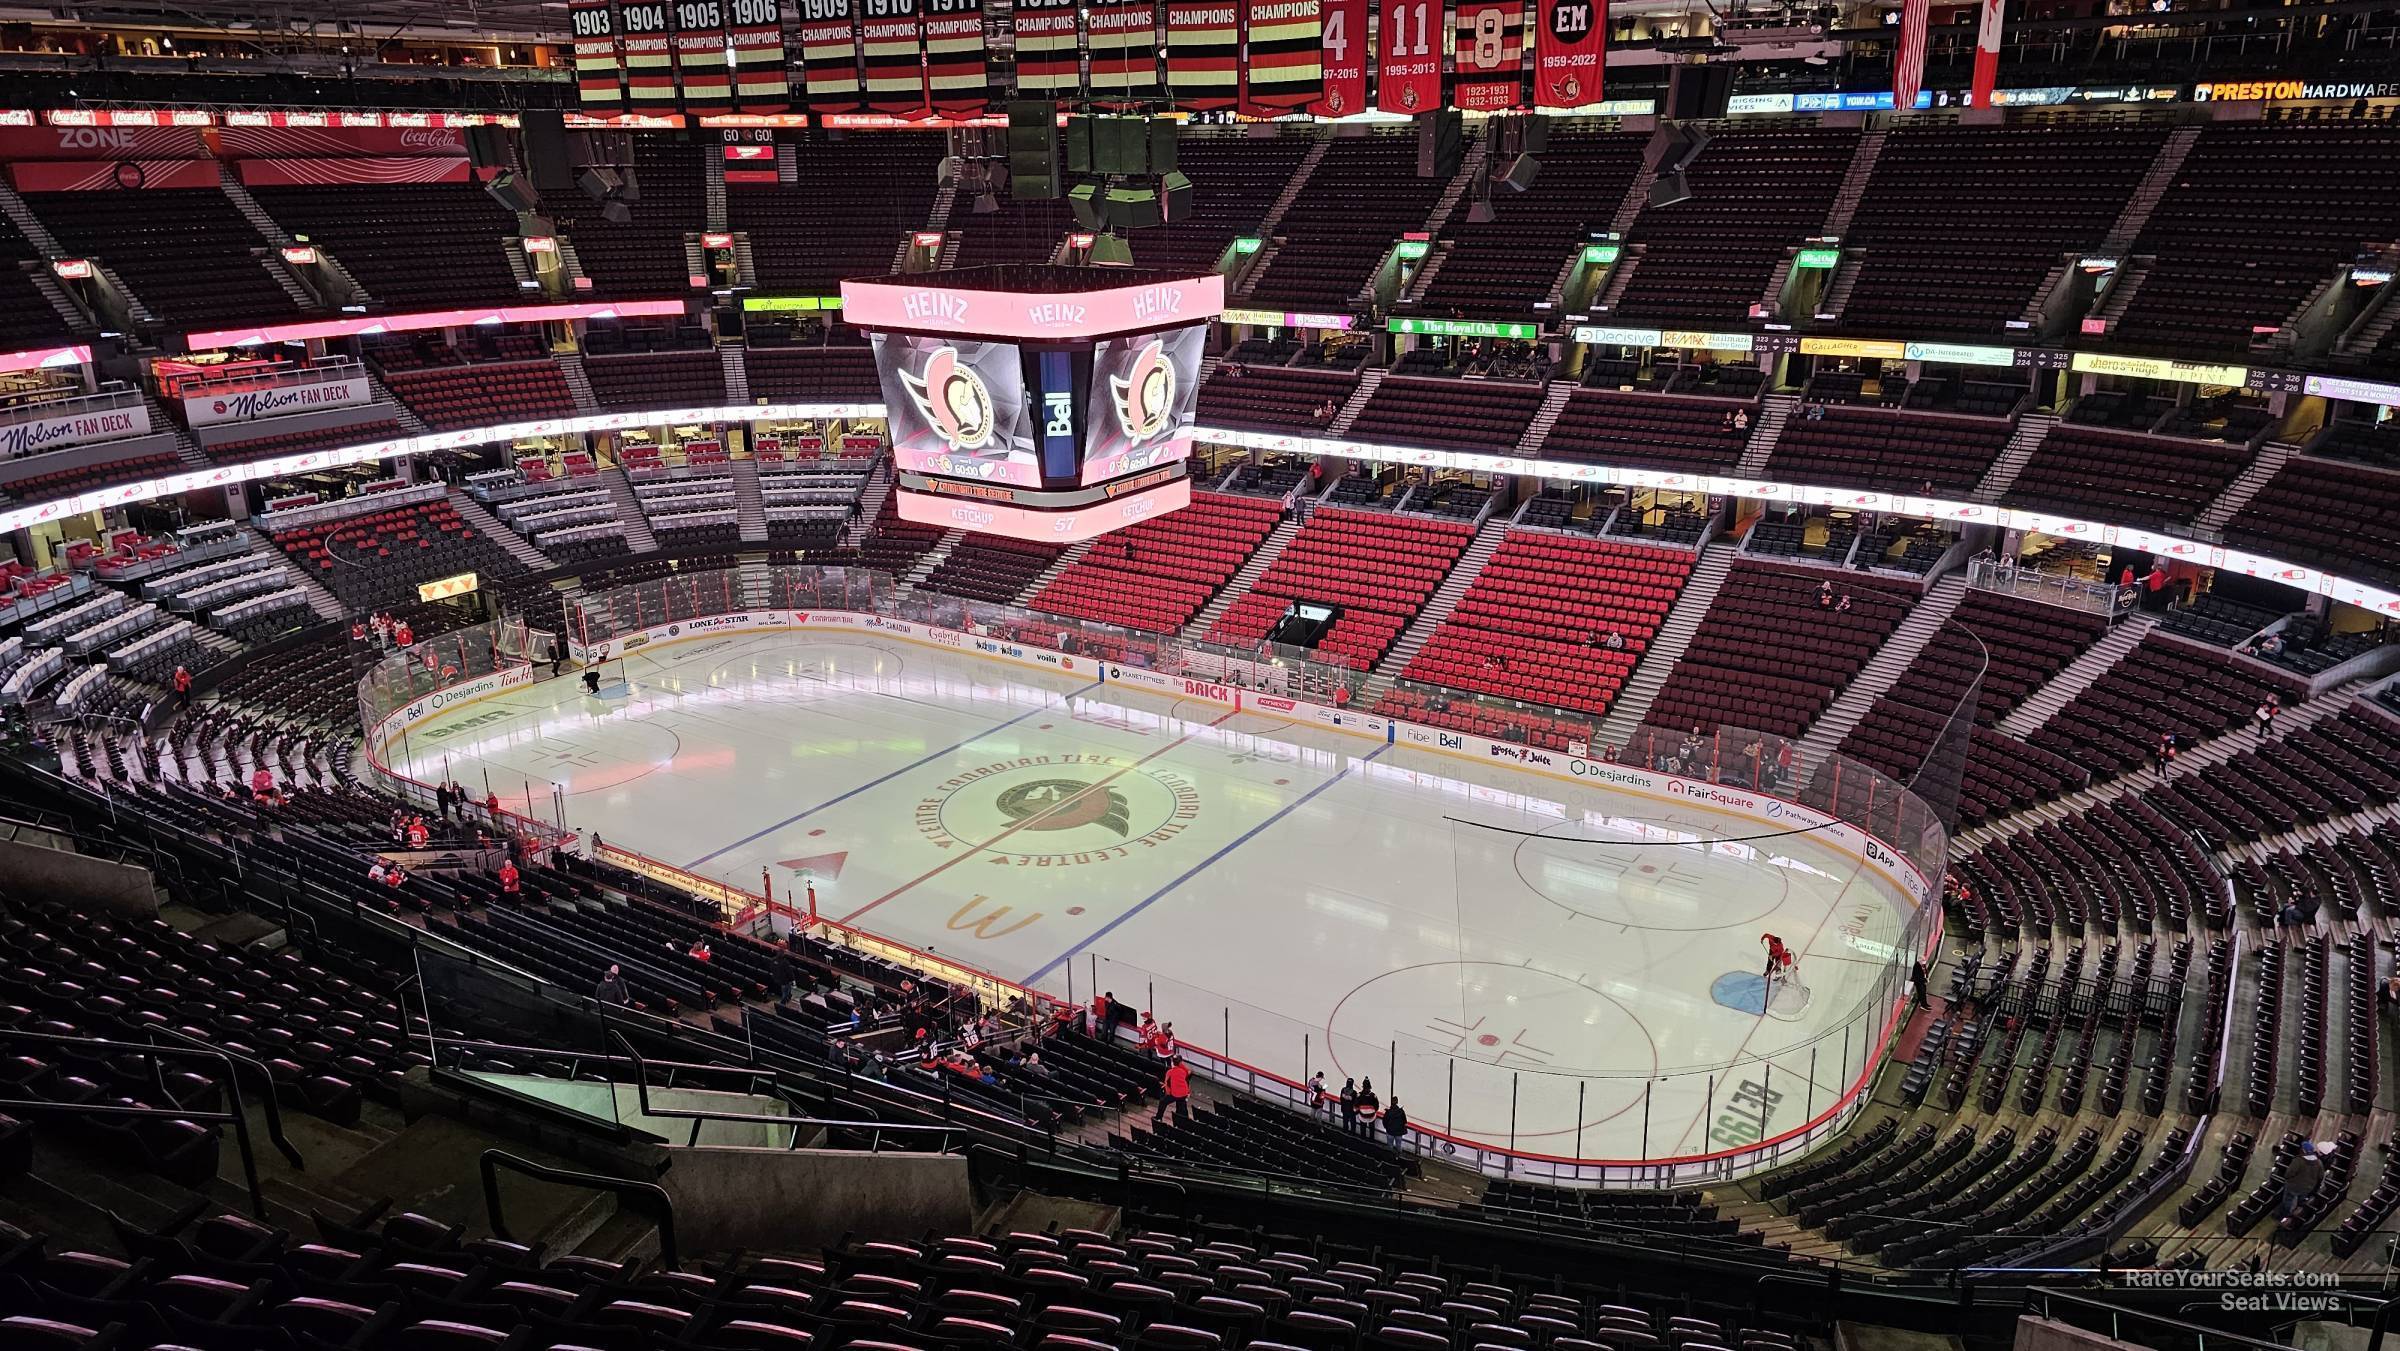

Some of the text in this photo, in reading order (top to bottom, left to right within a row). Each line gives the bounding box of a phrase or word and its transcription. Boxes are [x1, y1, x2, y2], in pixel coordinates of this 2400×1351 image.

[623, 5, 665, 31] 1904
[677, 2, 721, 28] 1905
[732, 0, 777, 24] 1906
[1169, 9, 1235, 25] CHAMPIONS
[1251, 0, 1320, 20] CHAMPIONS
[1556, 4, 1588, 33] EM
[573, 9, 611, 35] 1903
[926, 18, 982, 35] CHAMPIONS
[1015, 16, 1075, 32] CHAMPIONS
[1089, 11, 1152, 29] CHAMPIONS
[734, 31, 781, 46] CHAMPIONS
[802, 26, 852, 42] CHAMPIONS
[864, 22, 917, 38] CHAMPIONS
[1323, 11, 1347, 61] 4
[1392, 3, 1429, 56] 11
[1475, 8, 1504, 69] 8
[575, 41, 614, 54] CHAMPIONS
[625, 38, 668, 51] CHAMPIONS
[679, 35, 724, 49] CHAMPIONS
[1384, 63, 1436, 76] 1995-2013
[1543, 54, 1597, 67] 1959-2022
[1323, 67, 1359, 80] 97-2015
[1466, 86, 1510, 96] 1923-1931
[1846, 94, 1876, 106] YOW.CA
[2211, 82, 2400, 101] PRESTON HARDWARE
[1466, 96, 1509, 106] 1932-1933
[57, 129, 138, 148] ZONE
[400, 128, 456, 147] Coca-Cola
[723, 129, 739, 142] GO
[902, 291, 968, 323] HEINZ
[1132, 286, 1182, 318] HEINZ
[1028, 303, 1086, 323] HEINZ
[1423, 321, 1499, 335] The Royal Oak
[1595, 329, 1656, 344] Decisive
[1664, 331, 1705, 346] RE/MAX
[2018, 350, 2032, 358] 324
[2251, 370, 2266, 378] 325
[229, 385, 351, 417] Molson FAN DECK
[1046, 392, 1072, 437] Bell
[2, 413, 133, 454] Molson FAN DECK
[952, 508, 994, 524] KETCHUP
[1122, 499, 1155, 518] KETCHUP
[689, 615, 749, 630] LONE STAR
[499, 671, 519, 688] Tim
[1122, 672, 1142, 681] PLANET
[446, 680, 494, 703] Desjardins
[1173, 678, 1229, 702] The BRICK
[407, 702, 424, 721] Bell
[1407, 728, 1430, 743] Fibe
[1439, 733, 1462, 750] Bell
[1491, 744, 1551, 766] Booster Juice
[936, 755, 1050, 791] CANADIAN
[1061, 754, 1117, 765] TIRE
[1589, 765, 1652, 788] Desjardins
[1687, 784, 1754, 809] FairSquare
[1017, 768, 1201, 867] CANADIAN TIRE CENTRE
[1784, 810, 1819, 828] Pathways
[1709, 1078, 1785, 1148] BET99
